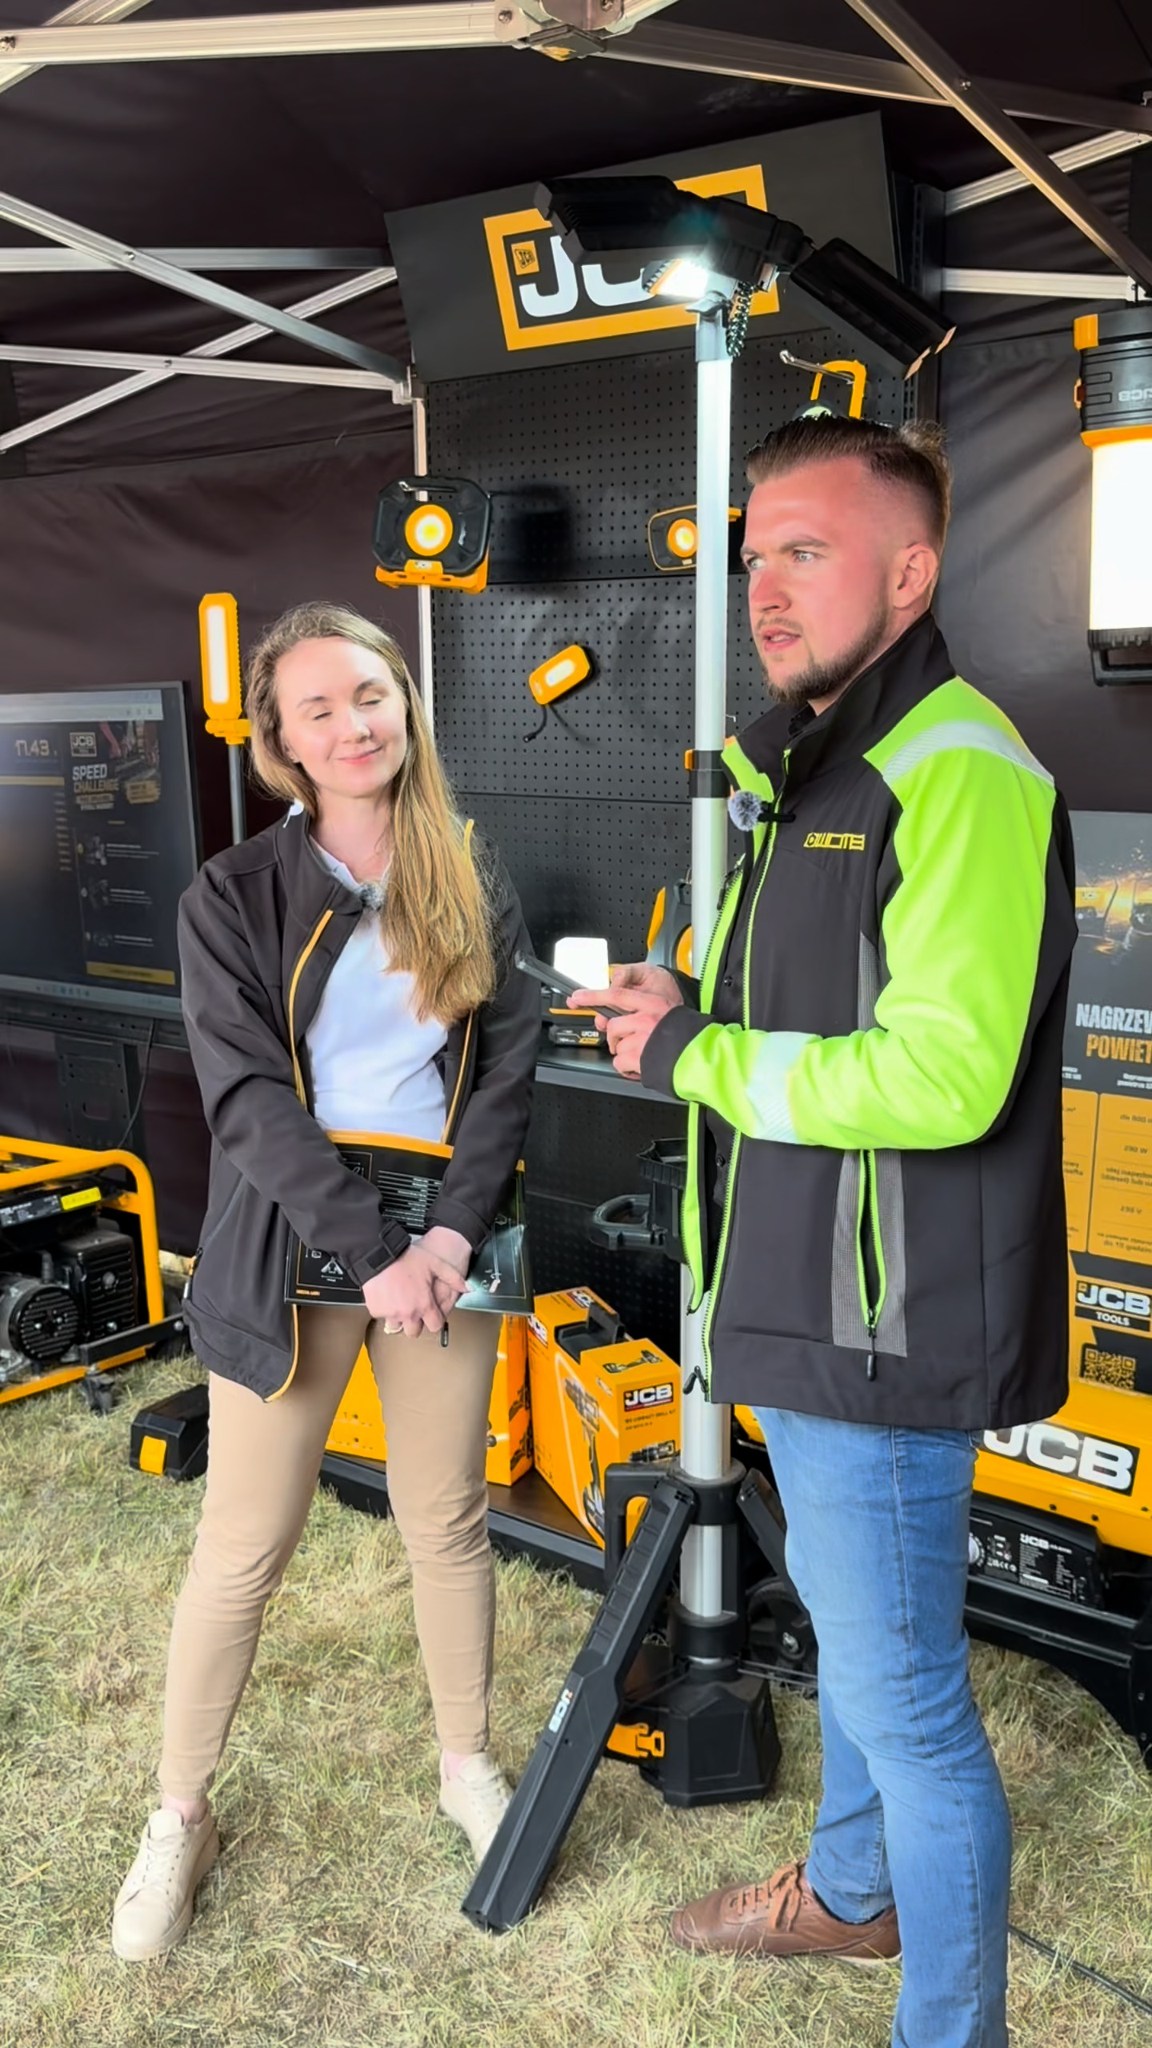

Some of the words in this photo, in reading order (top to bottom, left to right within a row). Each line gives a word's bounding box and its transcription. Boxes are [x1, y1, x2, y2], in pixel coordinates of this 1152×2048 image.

[72, 736, 94, 746] JCB
[72, 763, 108, 780] SPEED
[1077, 1284, 1151, 1316] JCB
[1096, 1311, 1130, 1327] TOOLS
[625, 1384, 672, 1406] JCB
[983, 1423, 1134, 1490] JCB
